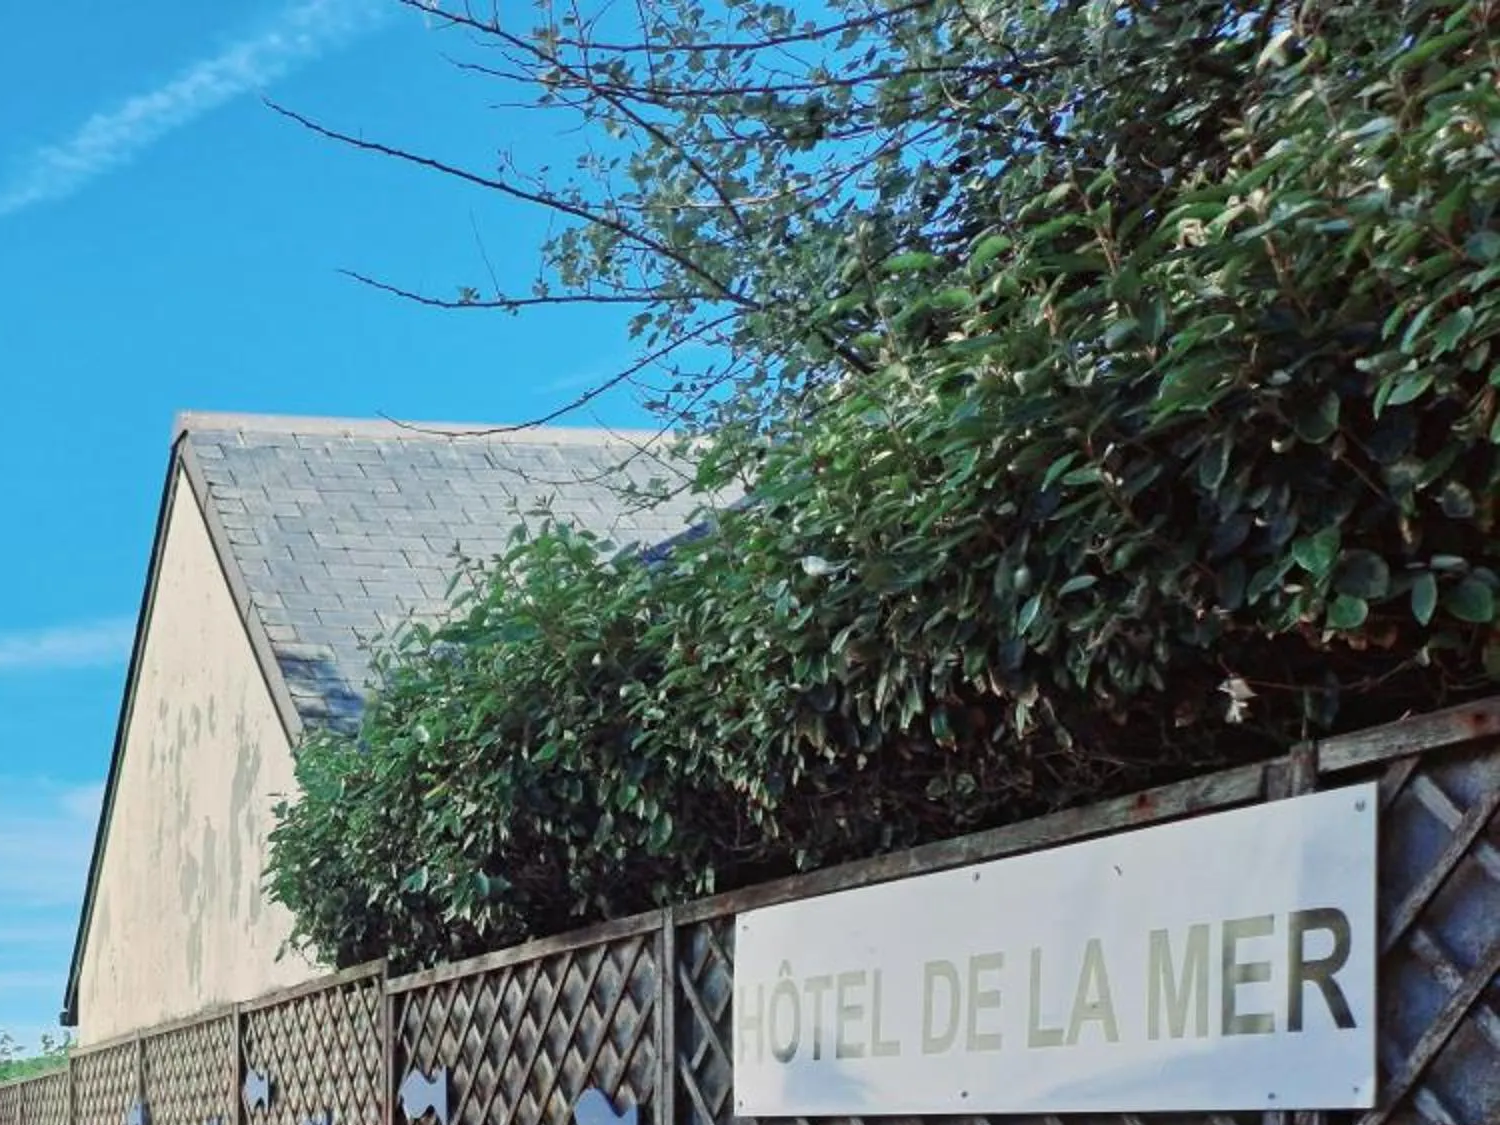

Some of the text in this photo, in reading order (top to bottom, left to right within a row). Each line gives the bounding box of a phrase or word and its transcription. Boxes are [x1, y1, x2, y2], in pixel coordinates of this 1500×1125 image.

[738, 907, 1357, 1064] HÔTEL DE LA MER
